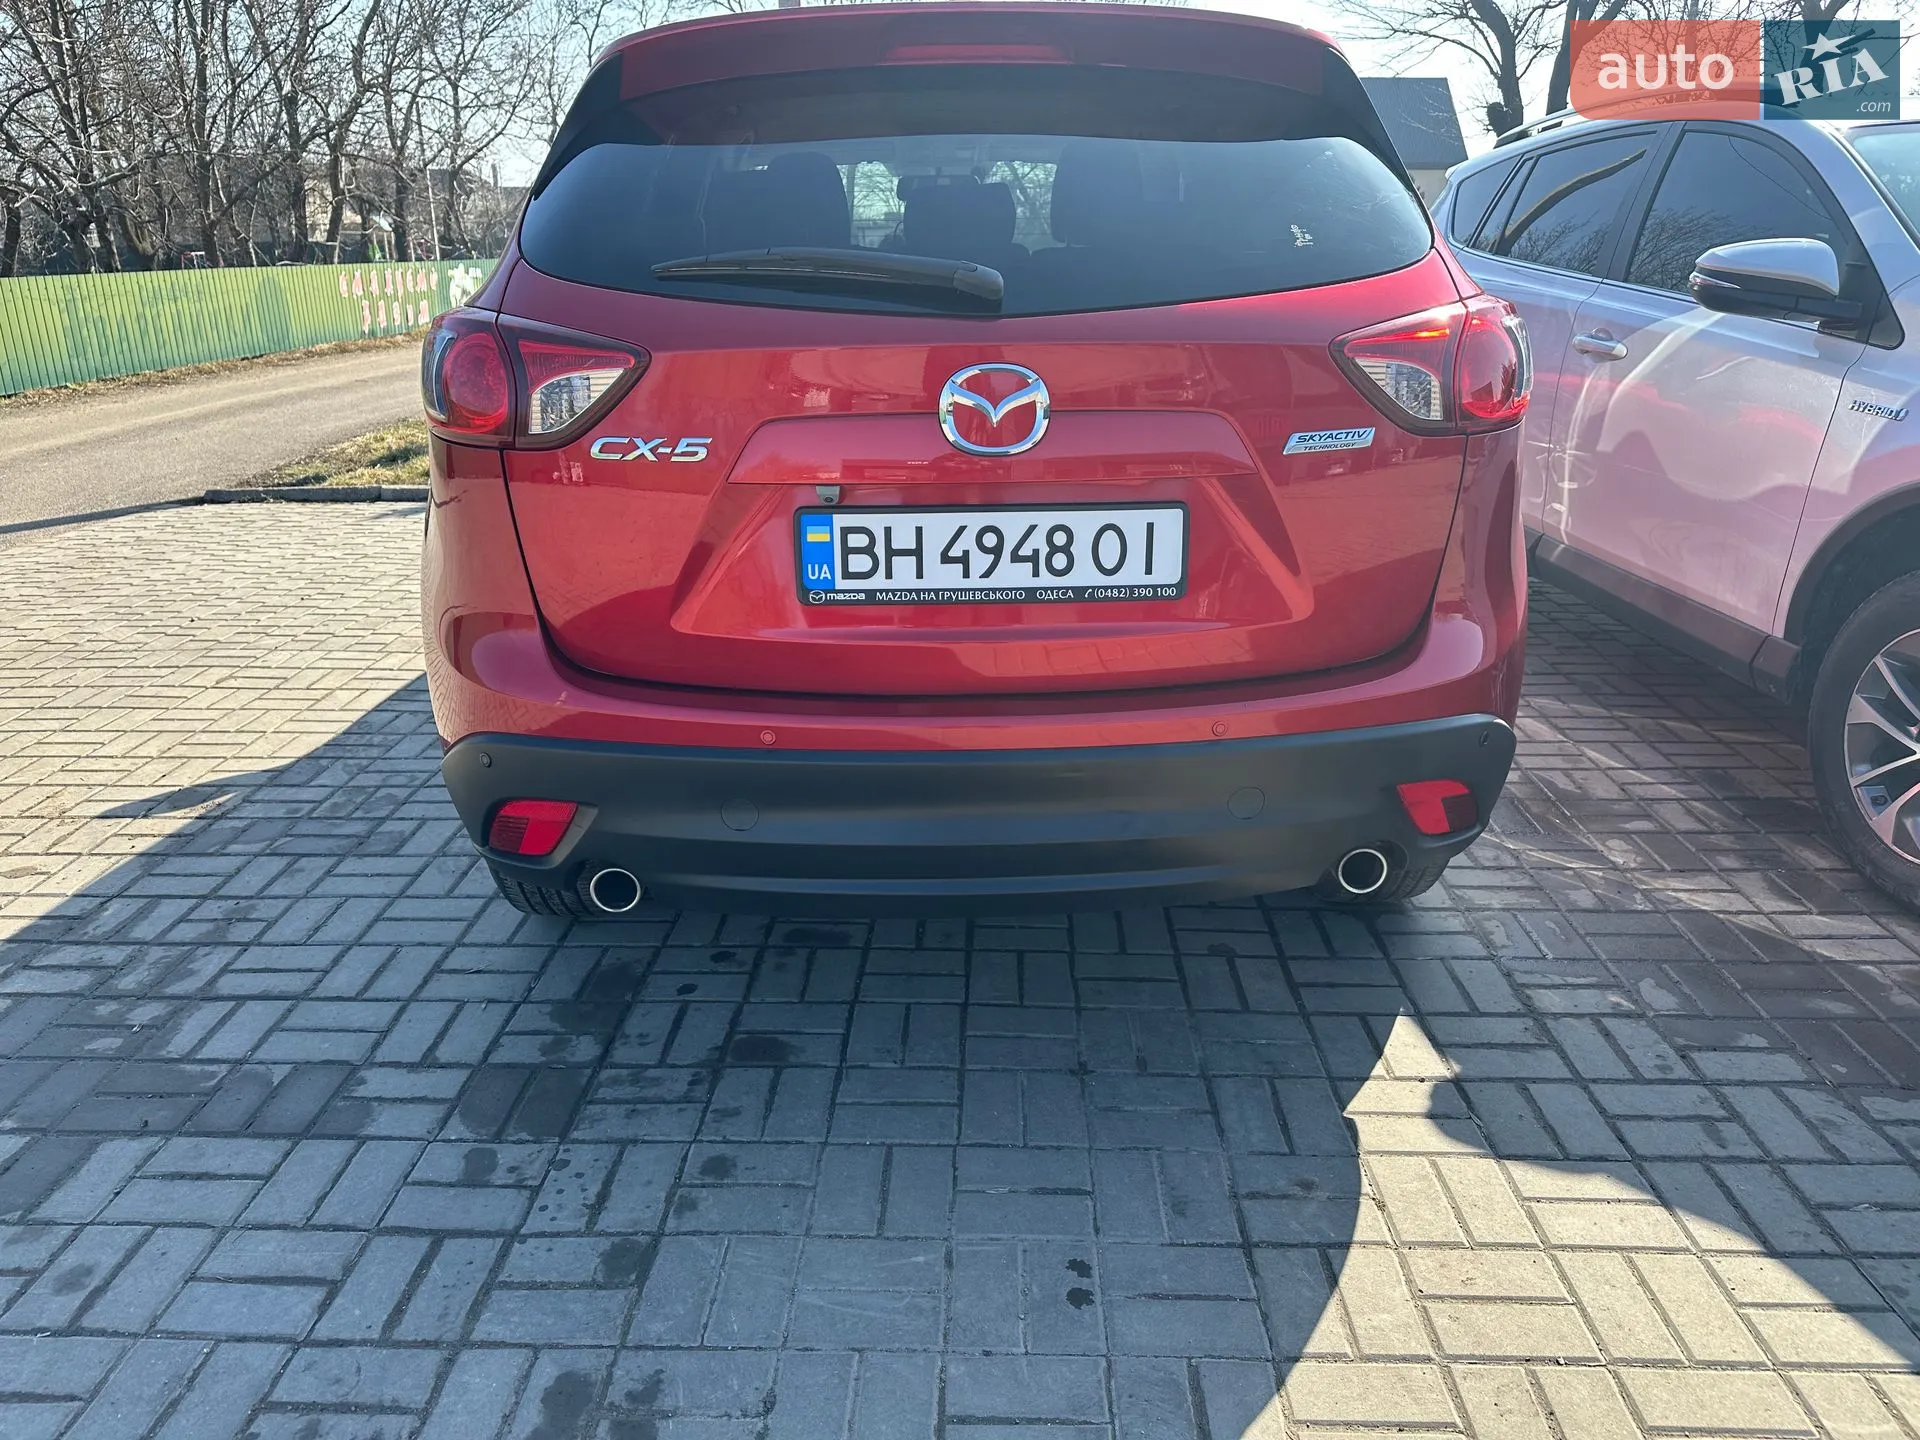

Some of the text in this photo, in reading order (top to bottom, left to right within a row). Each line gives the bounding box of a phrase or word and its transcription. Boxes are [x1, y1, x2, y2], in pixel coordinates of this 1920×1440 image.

[1848, 400, 1898, 420] HYBRID
[1295, 429, 1368, 444] SKYACTIV
[590, 437, 713, 462] CX-5
[1303, 442, 1356, 451] TECHNOLOGY
[939, 522, 1075, 580] 4948
[807, 563, 832, 581] UA
[826, 592, 866, 600] mazda
[875, 587, 1177, 602] MAZDA НА ГРУШЕВСЬКОГО ОДЕСА (0482) 390 100
